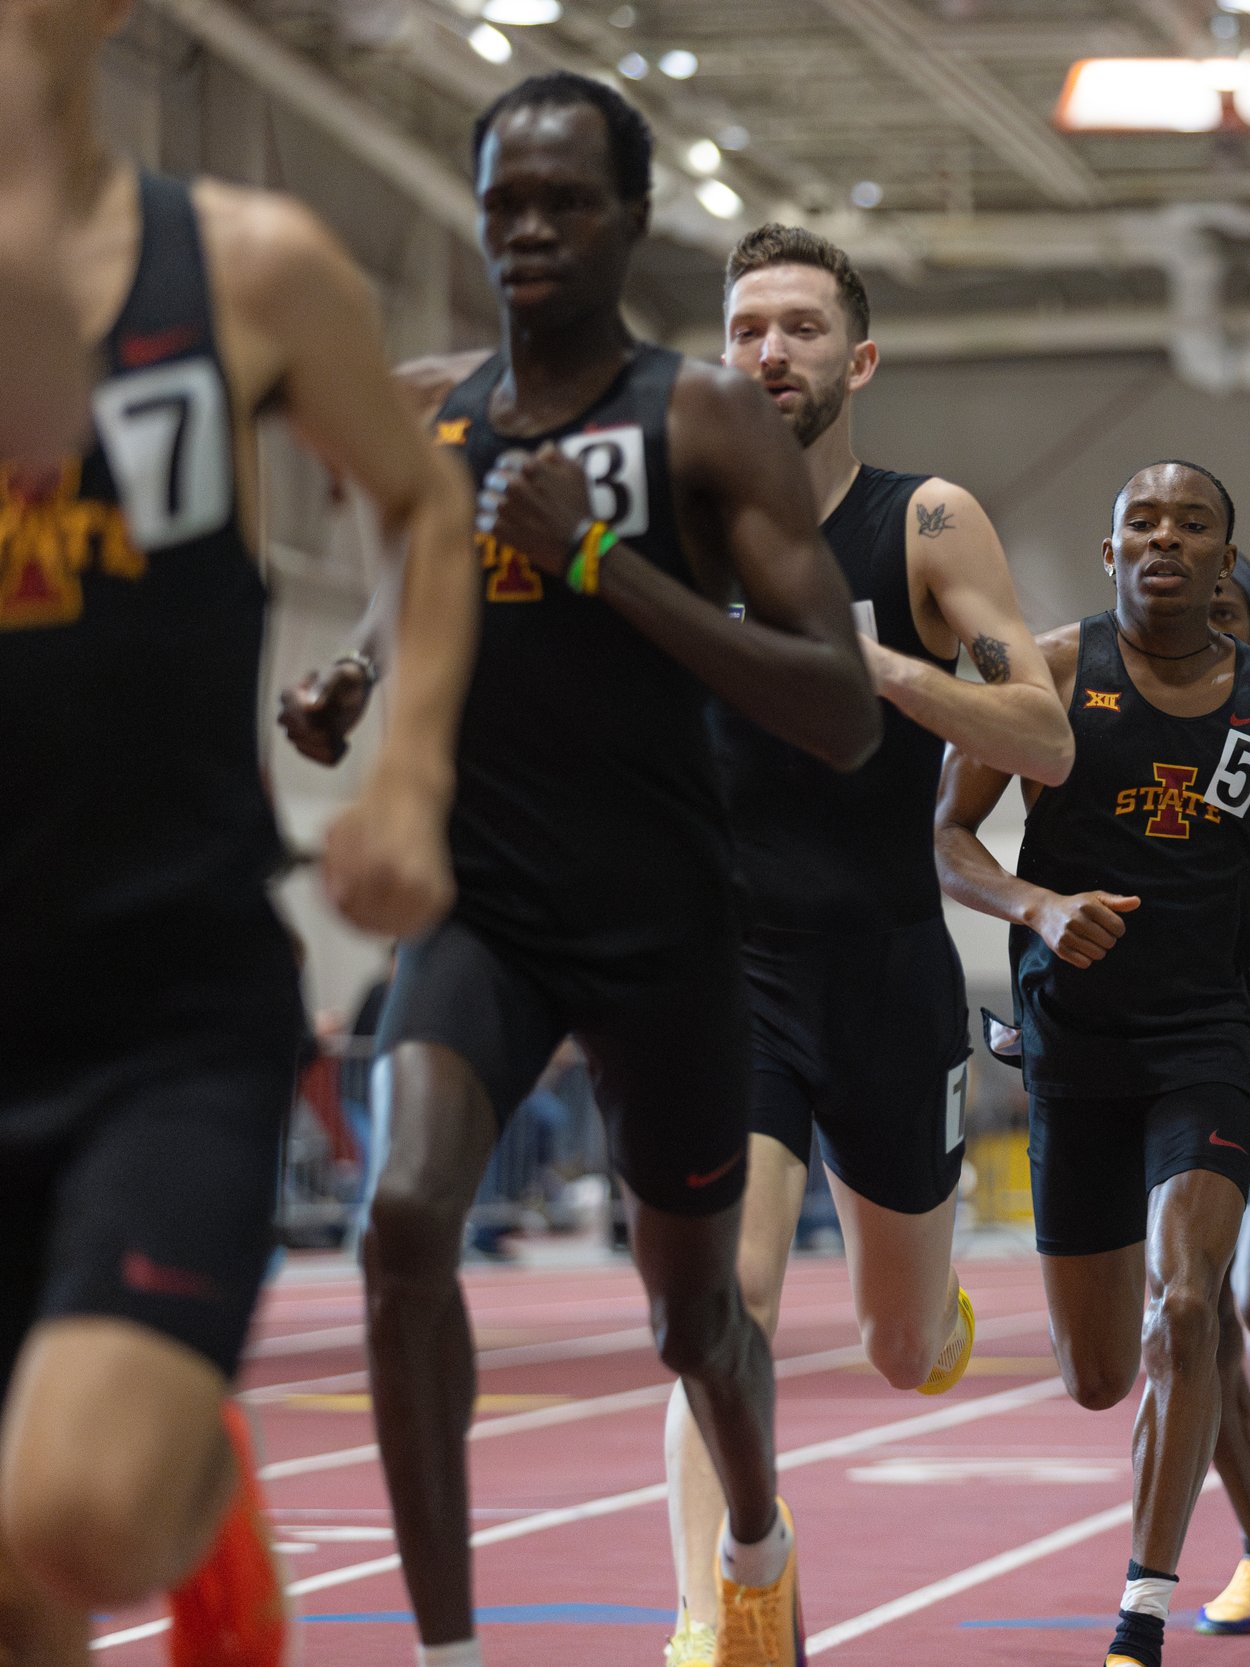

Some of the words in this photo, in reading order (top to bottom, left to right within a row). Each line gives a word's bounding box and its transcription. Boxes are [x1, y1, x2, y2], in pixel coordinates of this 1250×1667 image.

[121, 389, 194, 519] 7
[577, 441, 633, 525] 3
[1084, 688, 1121, 712] XII
